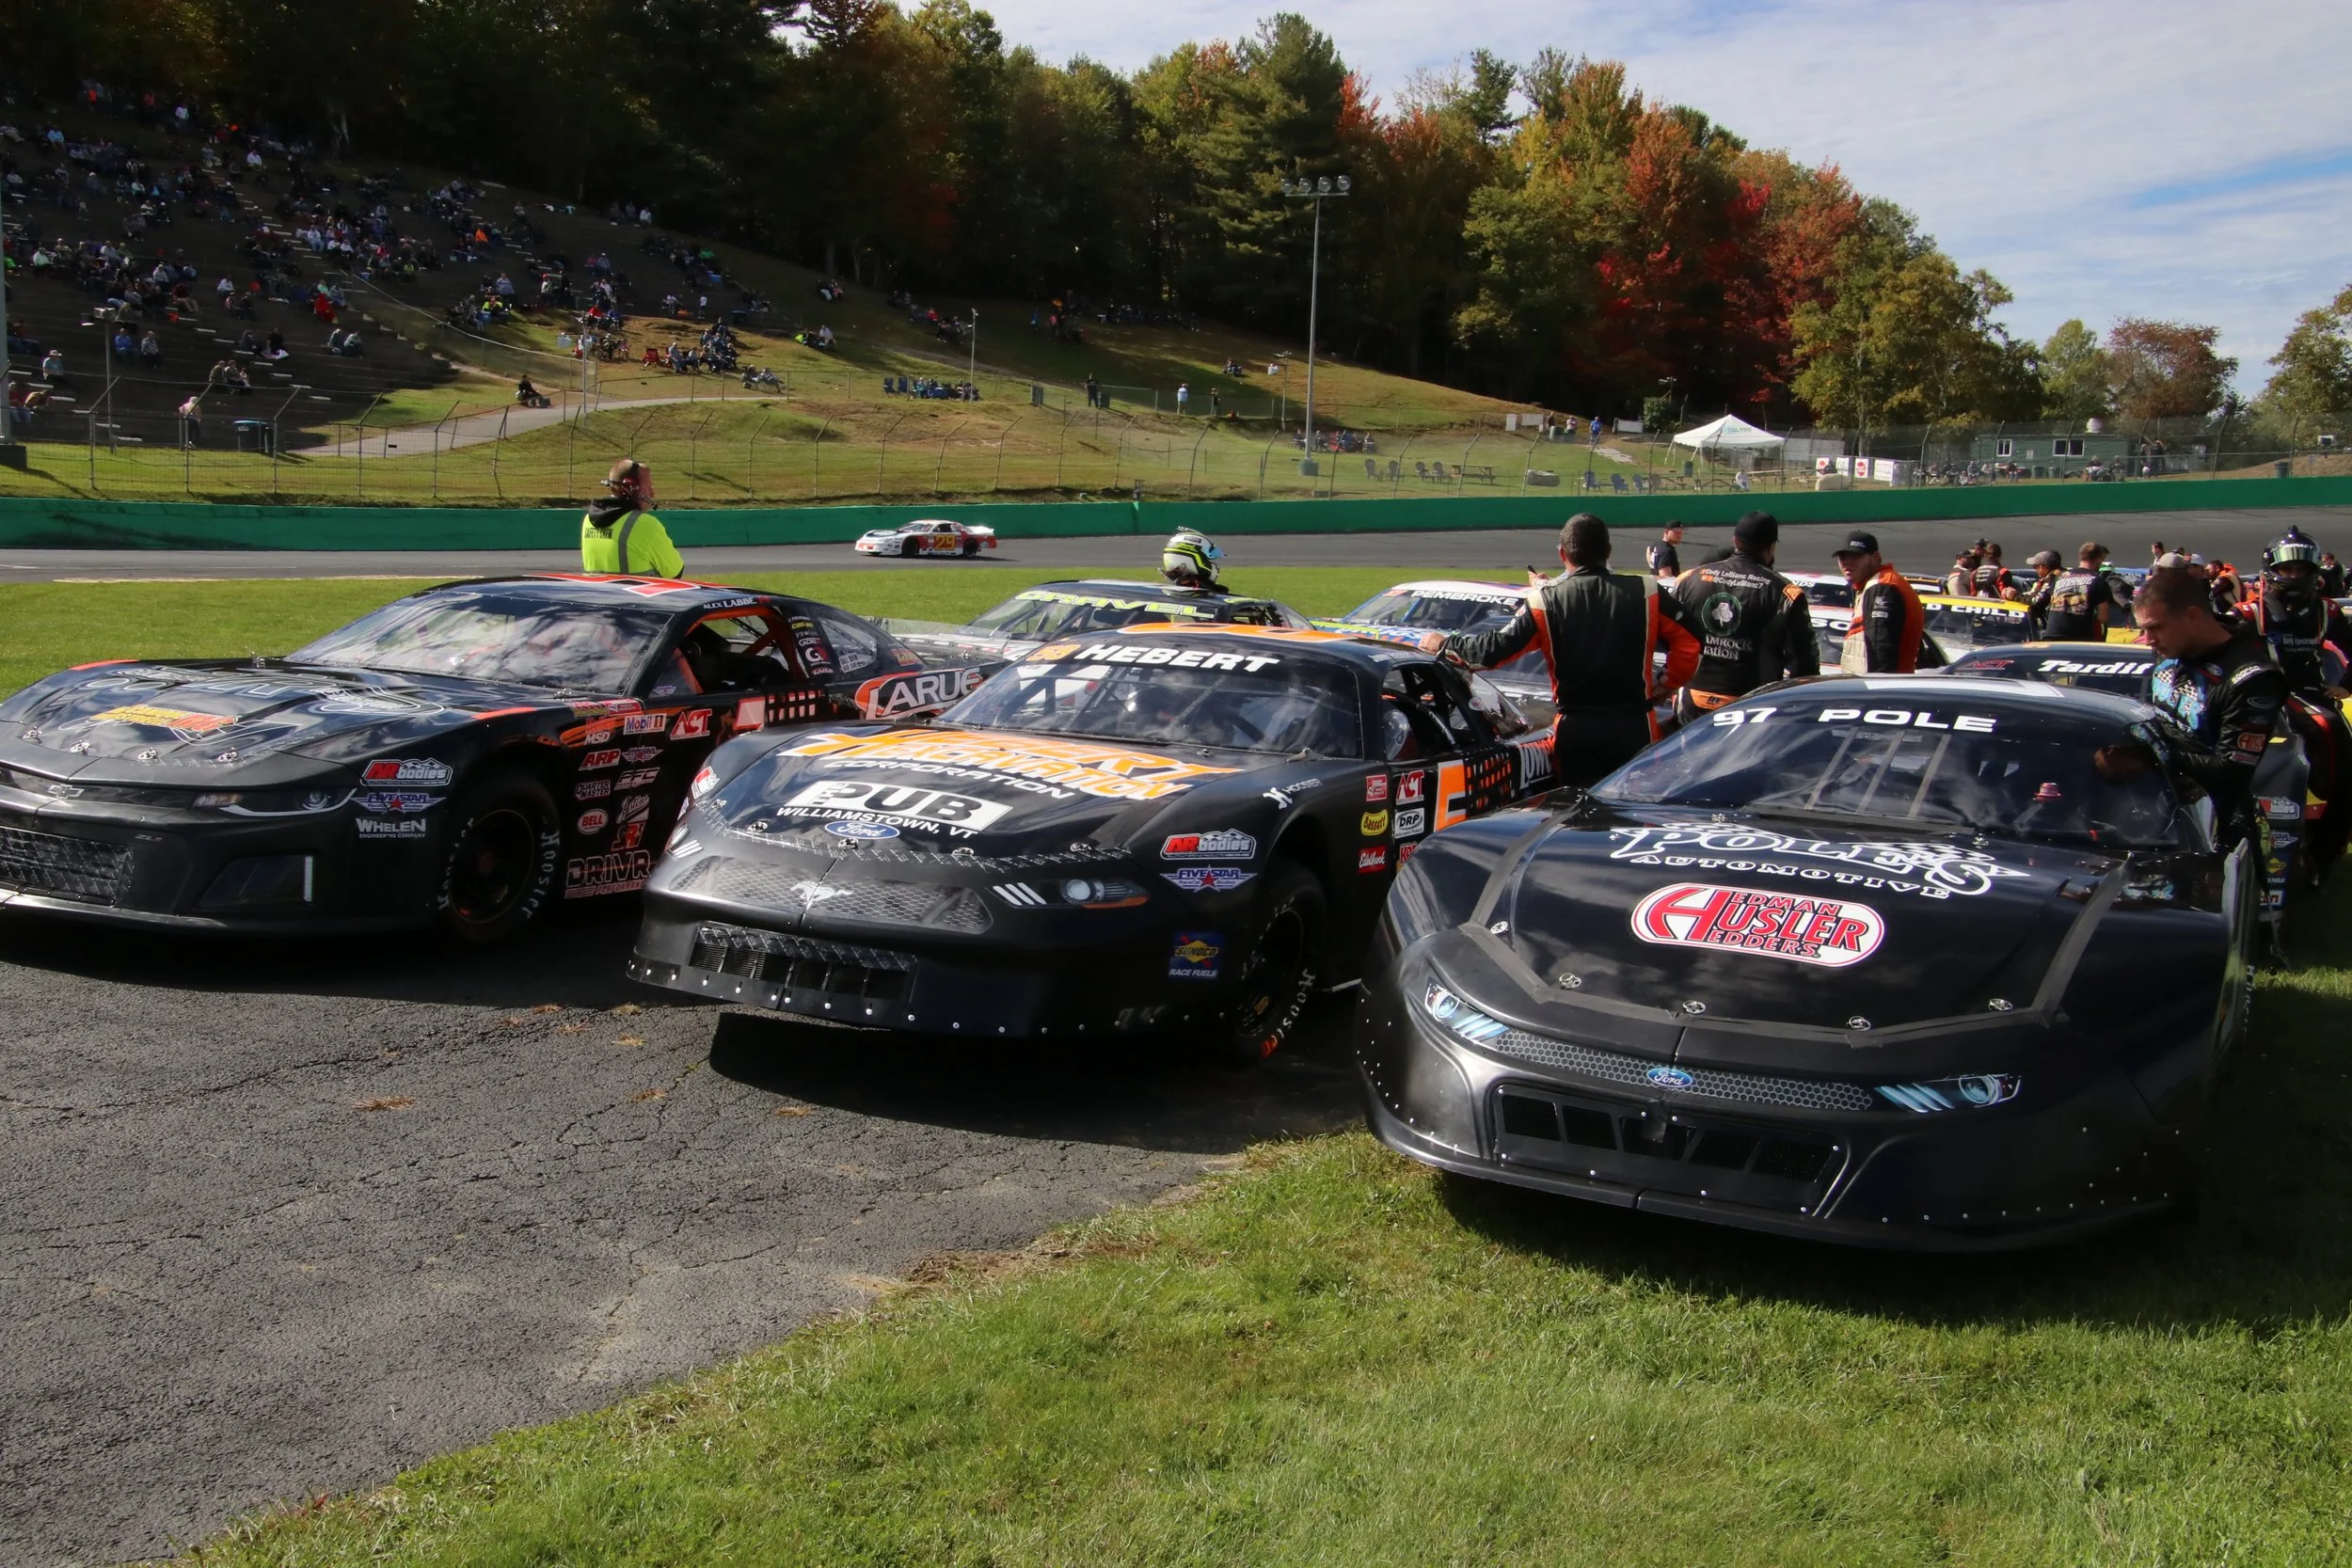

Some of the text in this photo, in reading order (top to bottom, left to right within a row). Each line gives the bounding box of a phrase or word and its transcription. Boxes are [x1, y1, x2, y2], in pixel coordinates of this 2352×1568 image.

[935, 534, 956, 551] 29
[1721, 570, 1747, 580] LeBlanc
[1747, 575, 1772, 585] Racing
[1015, 591, 1215, 619] GRAVEL
[1410, 590, 1519, 606] PEMBROKE
[1950, 605, 2025, 618] CHILD
[1073, 643, 1280, 673] HEBERT
[2038, 659, 2154, 675] Tardif
[865, 667, 980, 721] LARUE
[626, 718, 652, 730] Mobil
[671, 709, 712, 736] ACT
[1713, 707, 1777, 727] 97
[1818, 709, 1997, 733] POLE
[584, 731, 611, 746] MSD
[581, 750, 621, 768] ARP
[775, 729, 1246, 783] HEBERT
[396, 766, 447, 780] bodies
[619, 768, 659, 784] PFC
[861, 743, 1194, 800] EXCAVATION
[576, 781, 610, 795] QUARTER
[823, 760, 1076, 800] CORPORATION
[1281, 778, 1324, 795] HOOSIER
[1396, 770, 1424, 800] ACT
[368, 793, 428, 802] FIVE STAR
[580, 788, 610, 799] MASTER
[809, 782, 848, 806] THE
[830, 783, 983, 822] PUB
[356, 817, 426, 832] WHELEN
[581, 814, 603, 827] BELL
[776, 807, 979, 839] WILLIAMSTOWN, VT
[1364, 815, 1386, 832] Bassett
[1399, 814, 1420, 828] DRP
[1198, 836, 1250, 851] bodies
[1359, 850, 1386, 868] Edelbrock
[1178, 869, 1240, 879] FIVE STAR
[1629, 854, 1950, 900] AUTOMOTIVE
[1175, 947, 1218, 957] SUNOCO
[1168, 968, 1218, 977] RACE FUELS
[1654, 1069, 1685, 1085] Ford
